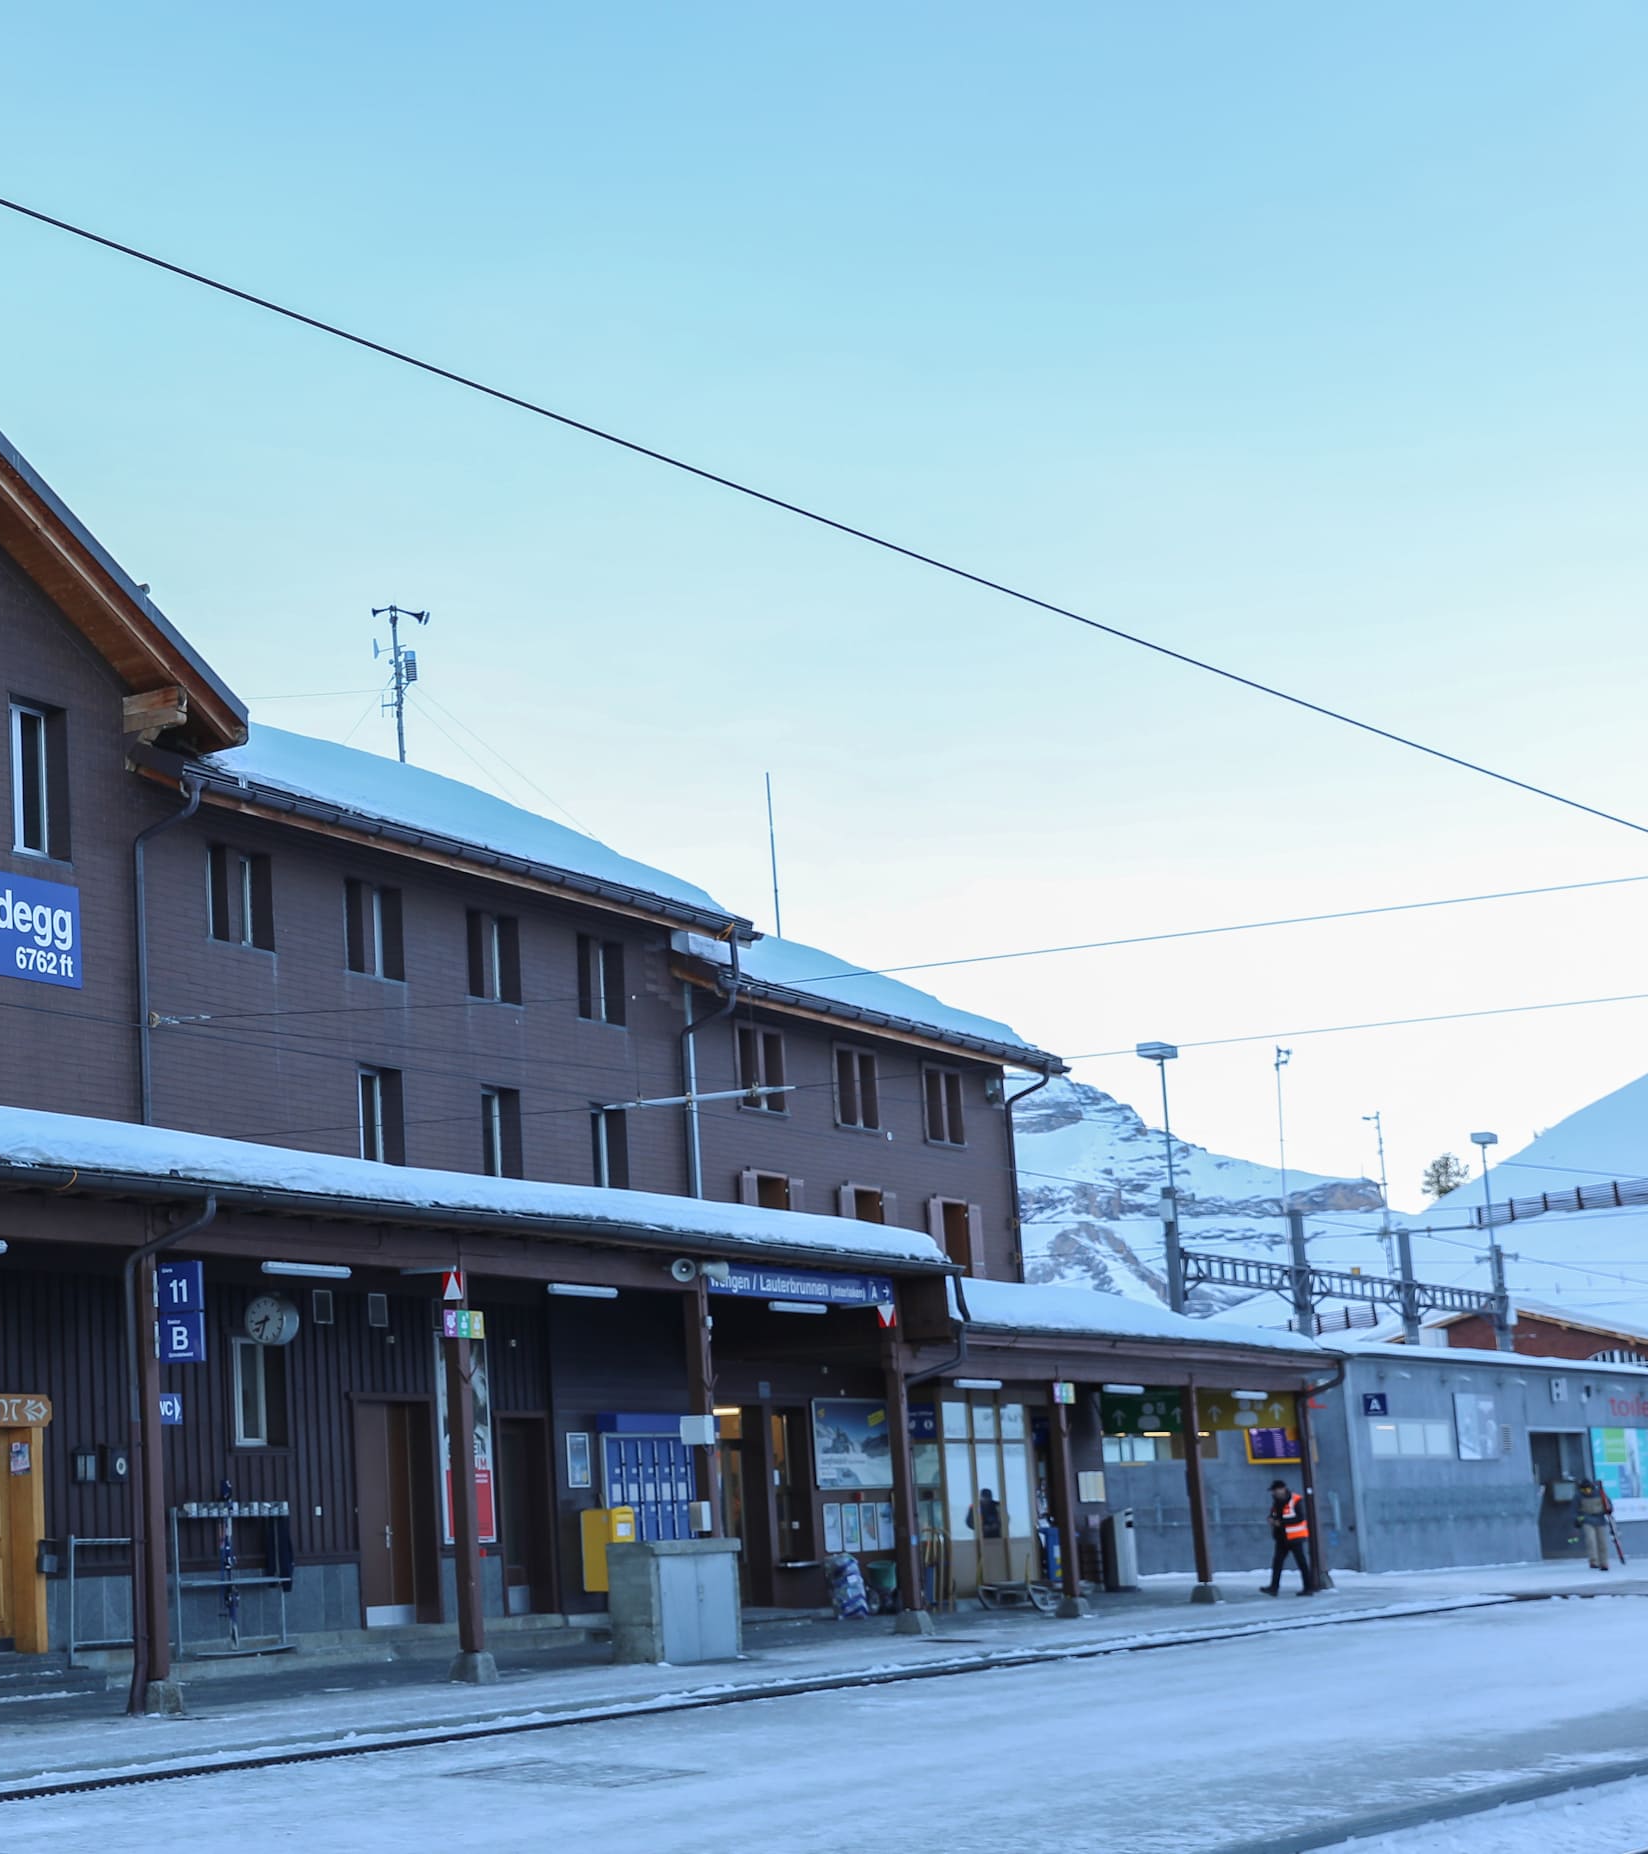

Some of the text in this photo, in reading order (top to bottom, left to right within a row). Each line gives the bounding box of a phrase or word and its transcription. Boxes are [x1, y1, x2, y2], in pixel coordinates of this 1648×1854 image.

[15, 946, 74, 978] 6762 ft
[169, 1279, 188, 1303] 11
[760, 1274, 829, 1297] Lauterbrunnen
[871, 1284, 878, 1299] A
[172, 1326, 189, 1350] B
[1369, 1398, 1382, 1411] A
